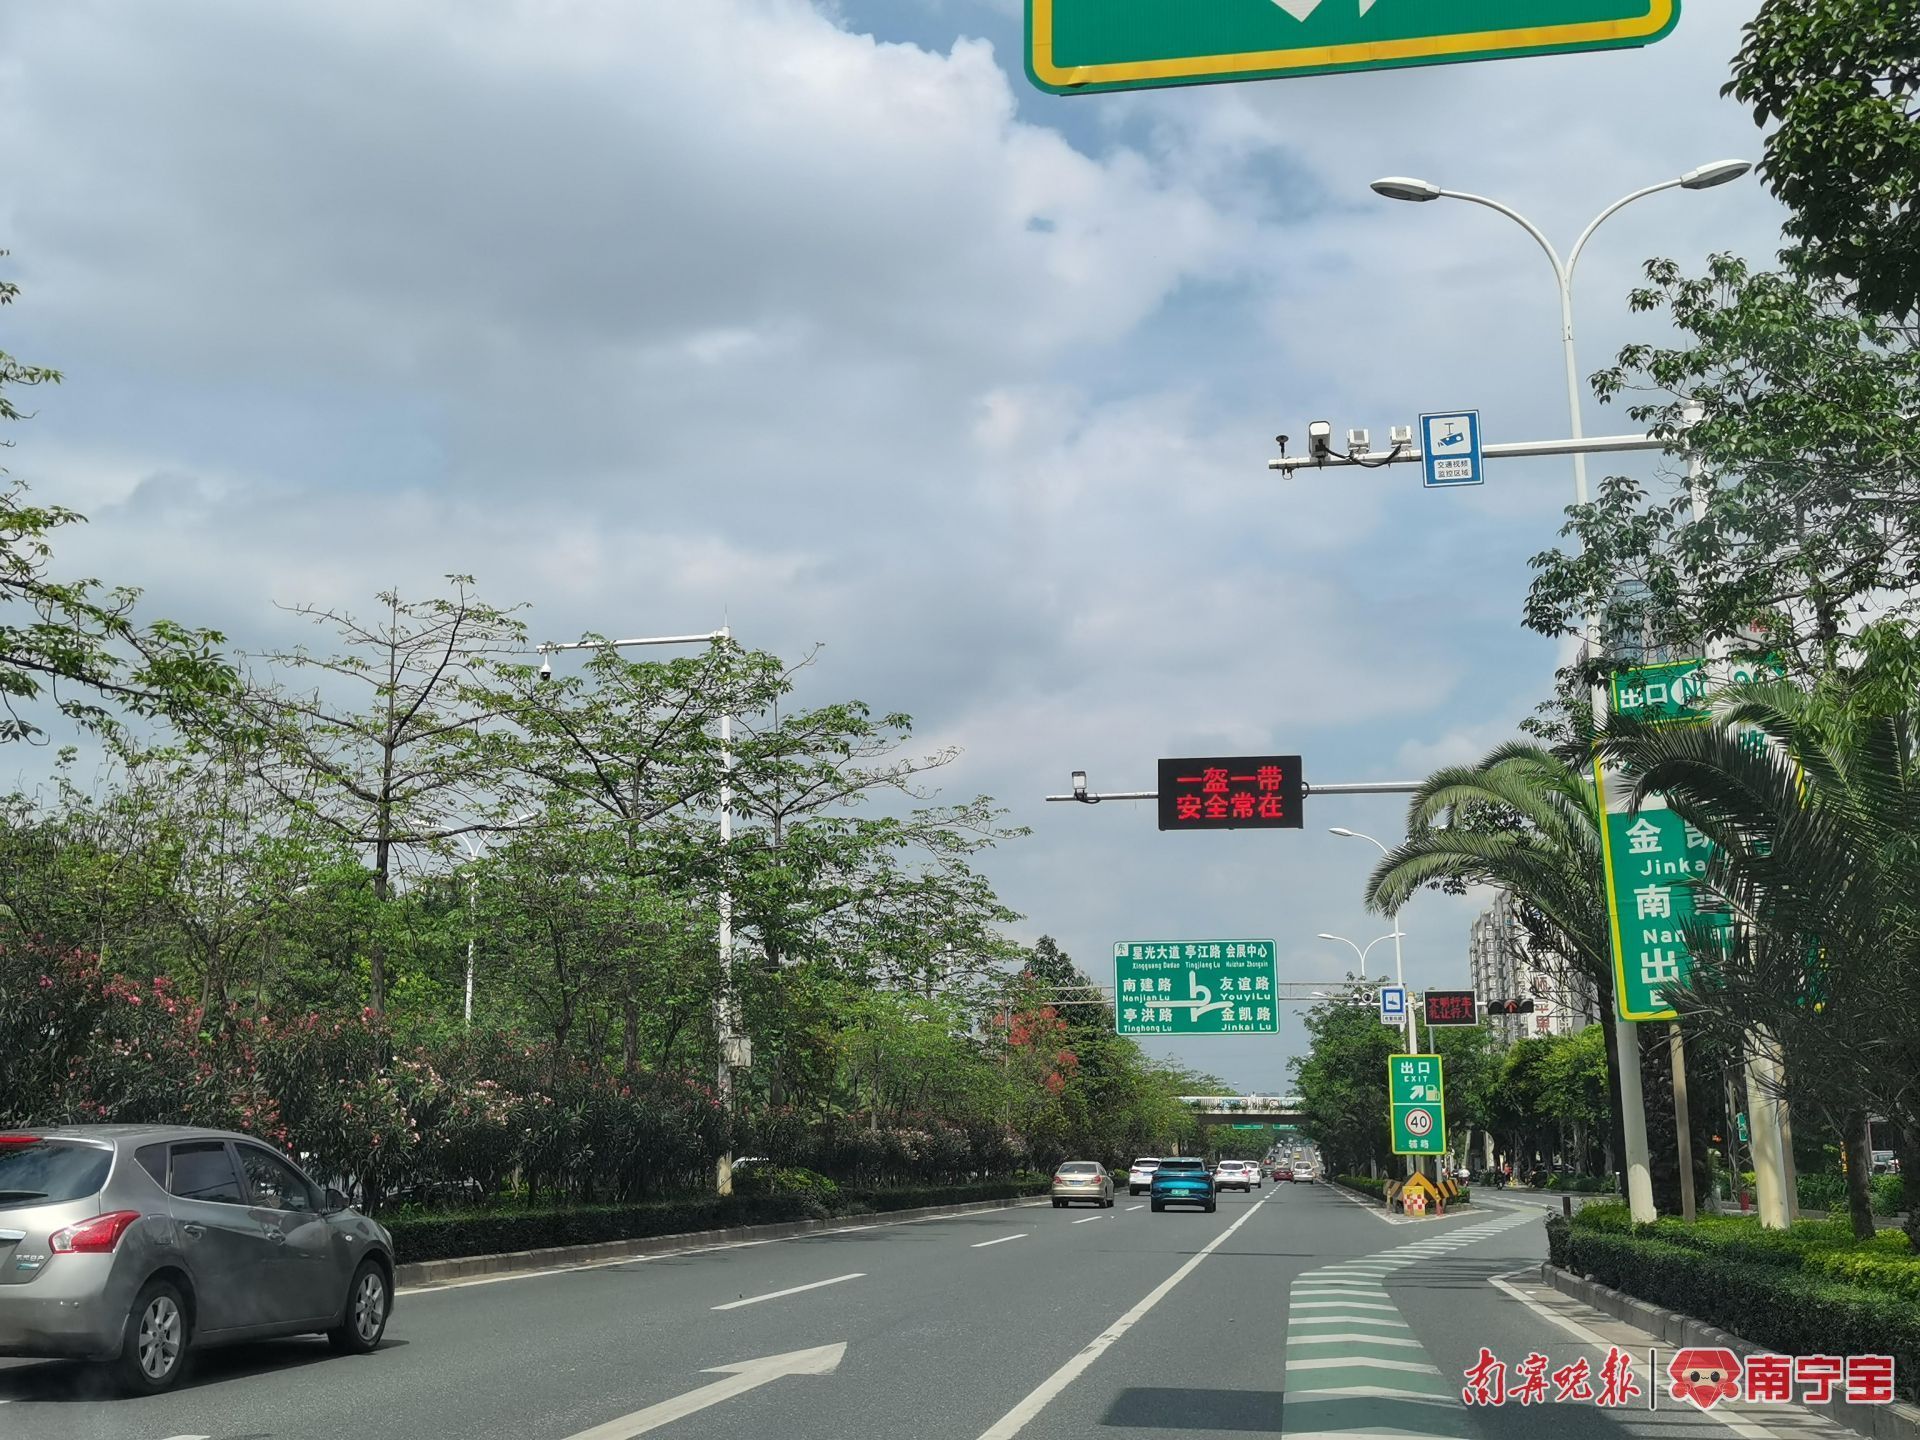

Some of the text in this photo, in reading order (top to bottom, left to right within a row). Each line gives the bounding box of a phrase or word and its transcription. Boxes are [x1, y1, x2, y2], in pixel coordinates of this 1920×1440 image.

[1438, 460, 1468, 468] 交通视频
[1620, 683, 1667, 709] 出口
[1177, 766, 1282, 792] 一盔一带
[1177, 792, 1283, 819] 安全常在
[1132, 943, 1268, 960] 星光大道 亭江路 会展中心
[1185, 961, 1212, 970] Tingjiang
[1122, 976, 1270, 992] 南建路 友谊路
[1122, 995, 1158, 1003] Nanjian
[1123, 1007, 1271, 1022] 亭洪路 金凯路
[1124, 1025, 1160, 1033] Tinghong
[1259, 1023, 1271, 1031] Lu
[1401, 1061, 1430, 1074] 出口
[1404, 1075, 1428, 1083] EXIT
[1411, 1115, 1428, 1128] 40
